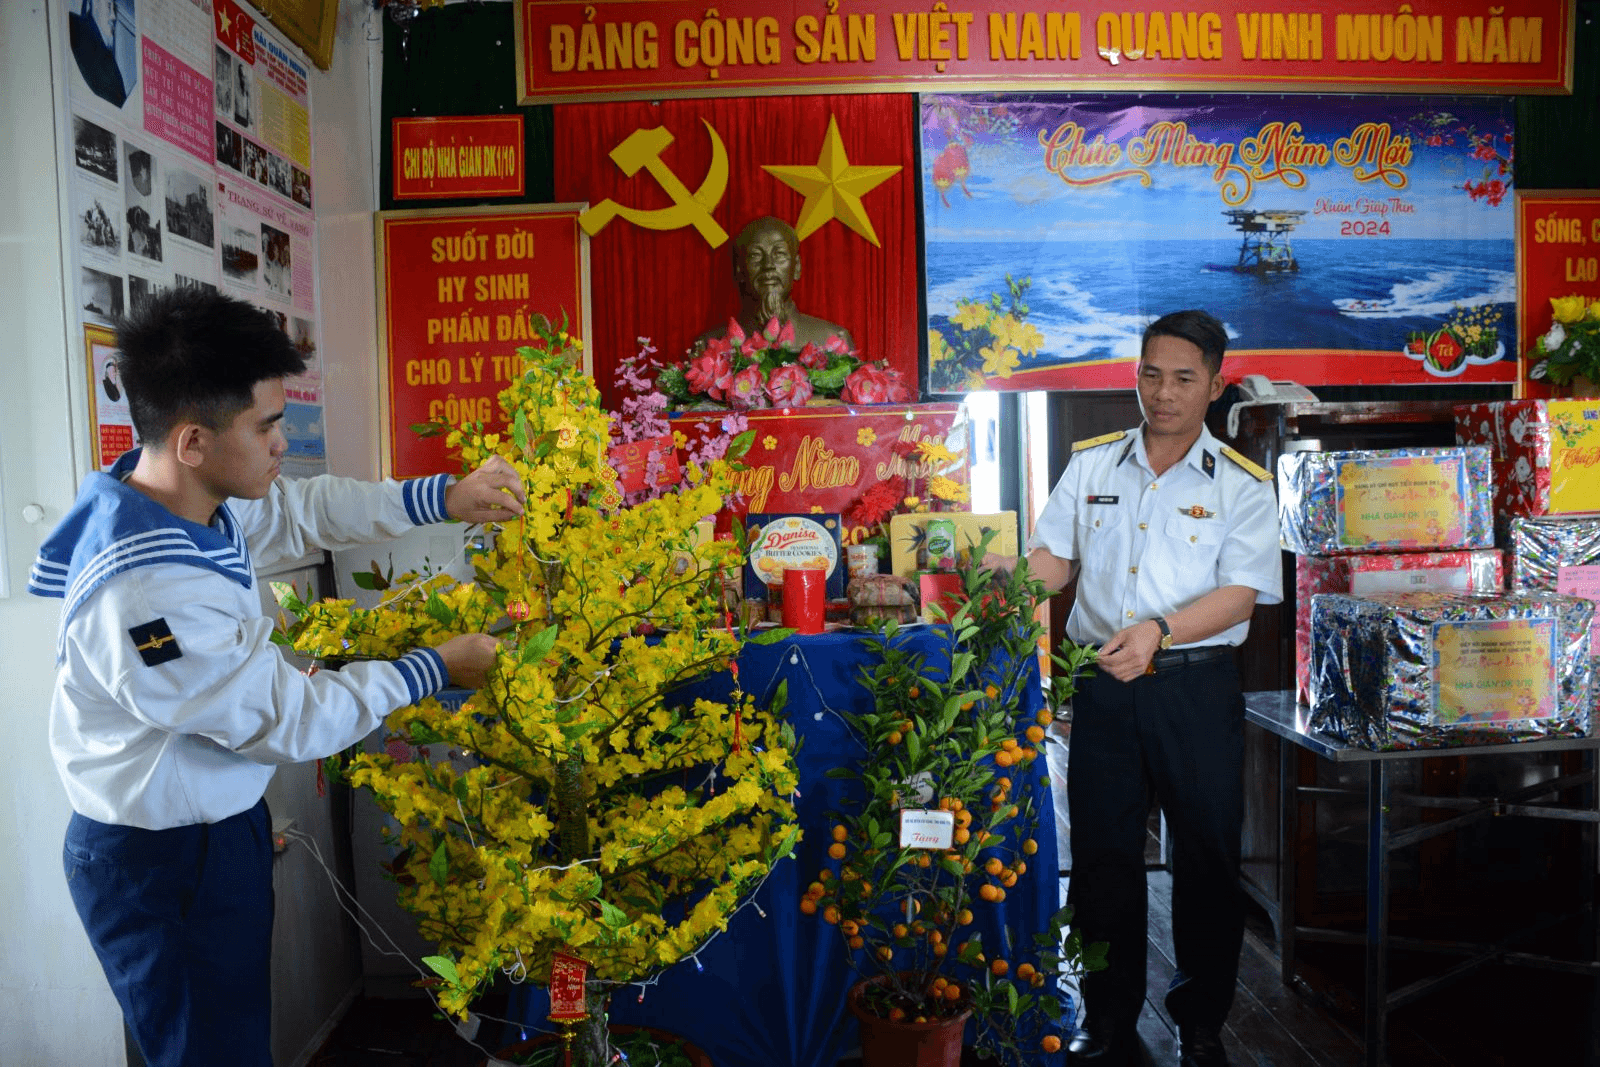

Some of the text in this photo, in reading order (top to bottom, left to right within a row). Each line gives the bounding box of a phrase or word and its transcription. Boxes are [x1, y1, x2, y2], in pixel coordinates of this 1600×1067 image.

[549, 0, 1543, 79] ĐẢNG CỘNG SẢN VIỆT NAM QUANG VINH MUÔN NĂM
[404, 147, 420, 179] CHI
[422, 139, 435, 189] BỘ
[437, 136, 457, 178] NHÀ
[1038, 121, 1412, 206] Chúc Mừng Năm Mới
[431, 226, 535, 262] SUỐT ĐỜI
[1340, 220, 1391, 237] 2024
[1534, 211, 1587, 246] SỐNG,
[1565, 256, 1598, 282] LAO
[438, 273, 530, 304] HY SINH
[427, 306, 490, 344] PHẤN
[406, 357, 453, 386] CHO
[459, 351, 484, 384] LÝ
[429, 393, 492, 426] CÔNG
[778, 434, 860, 493] Năm
[763, 527, 819, 550] Danisa
